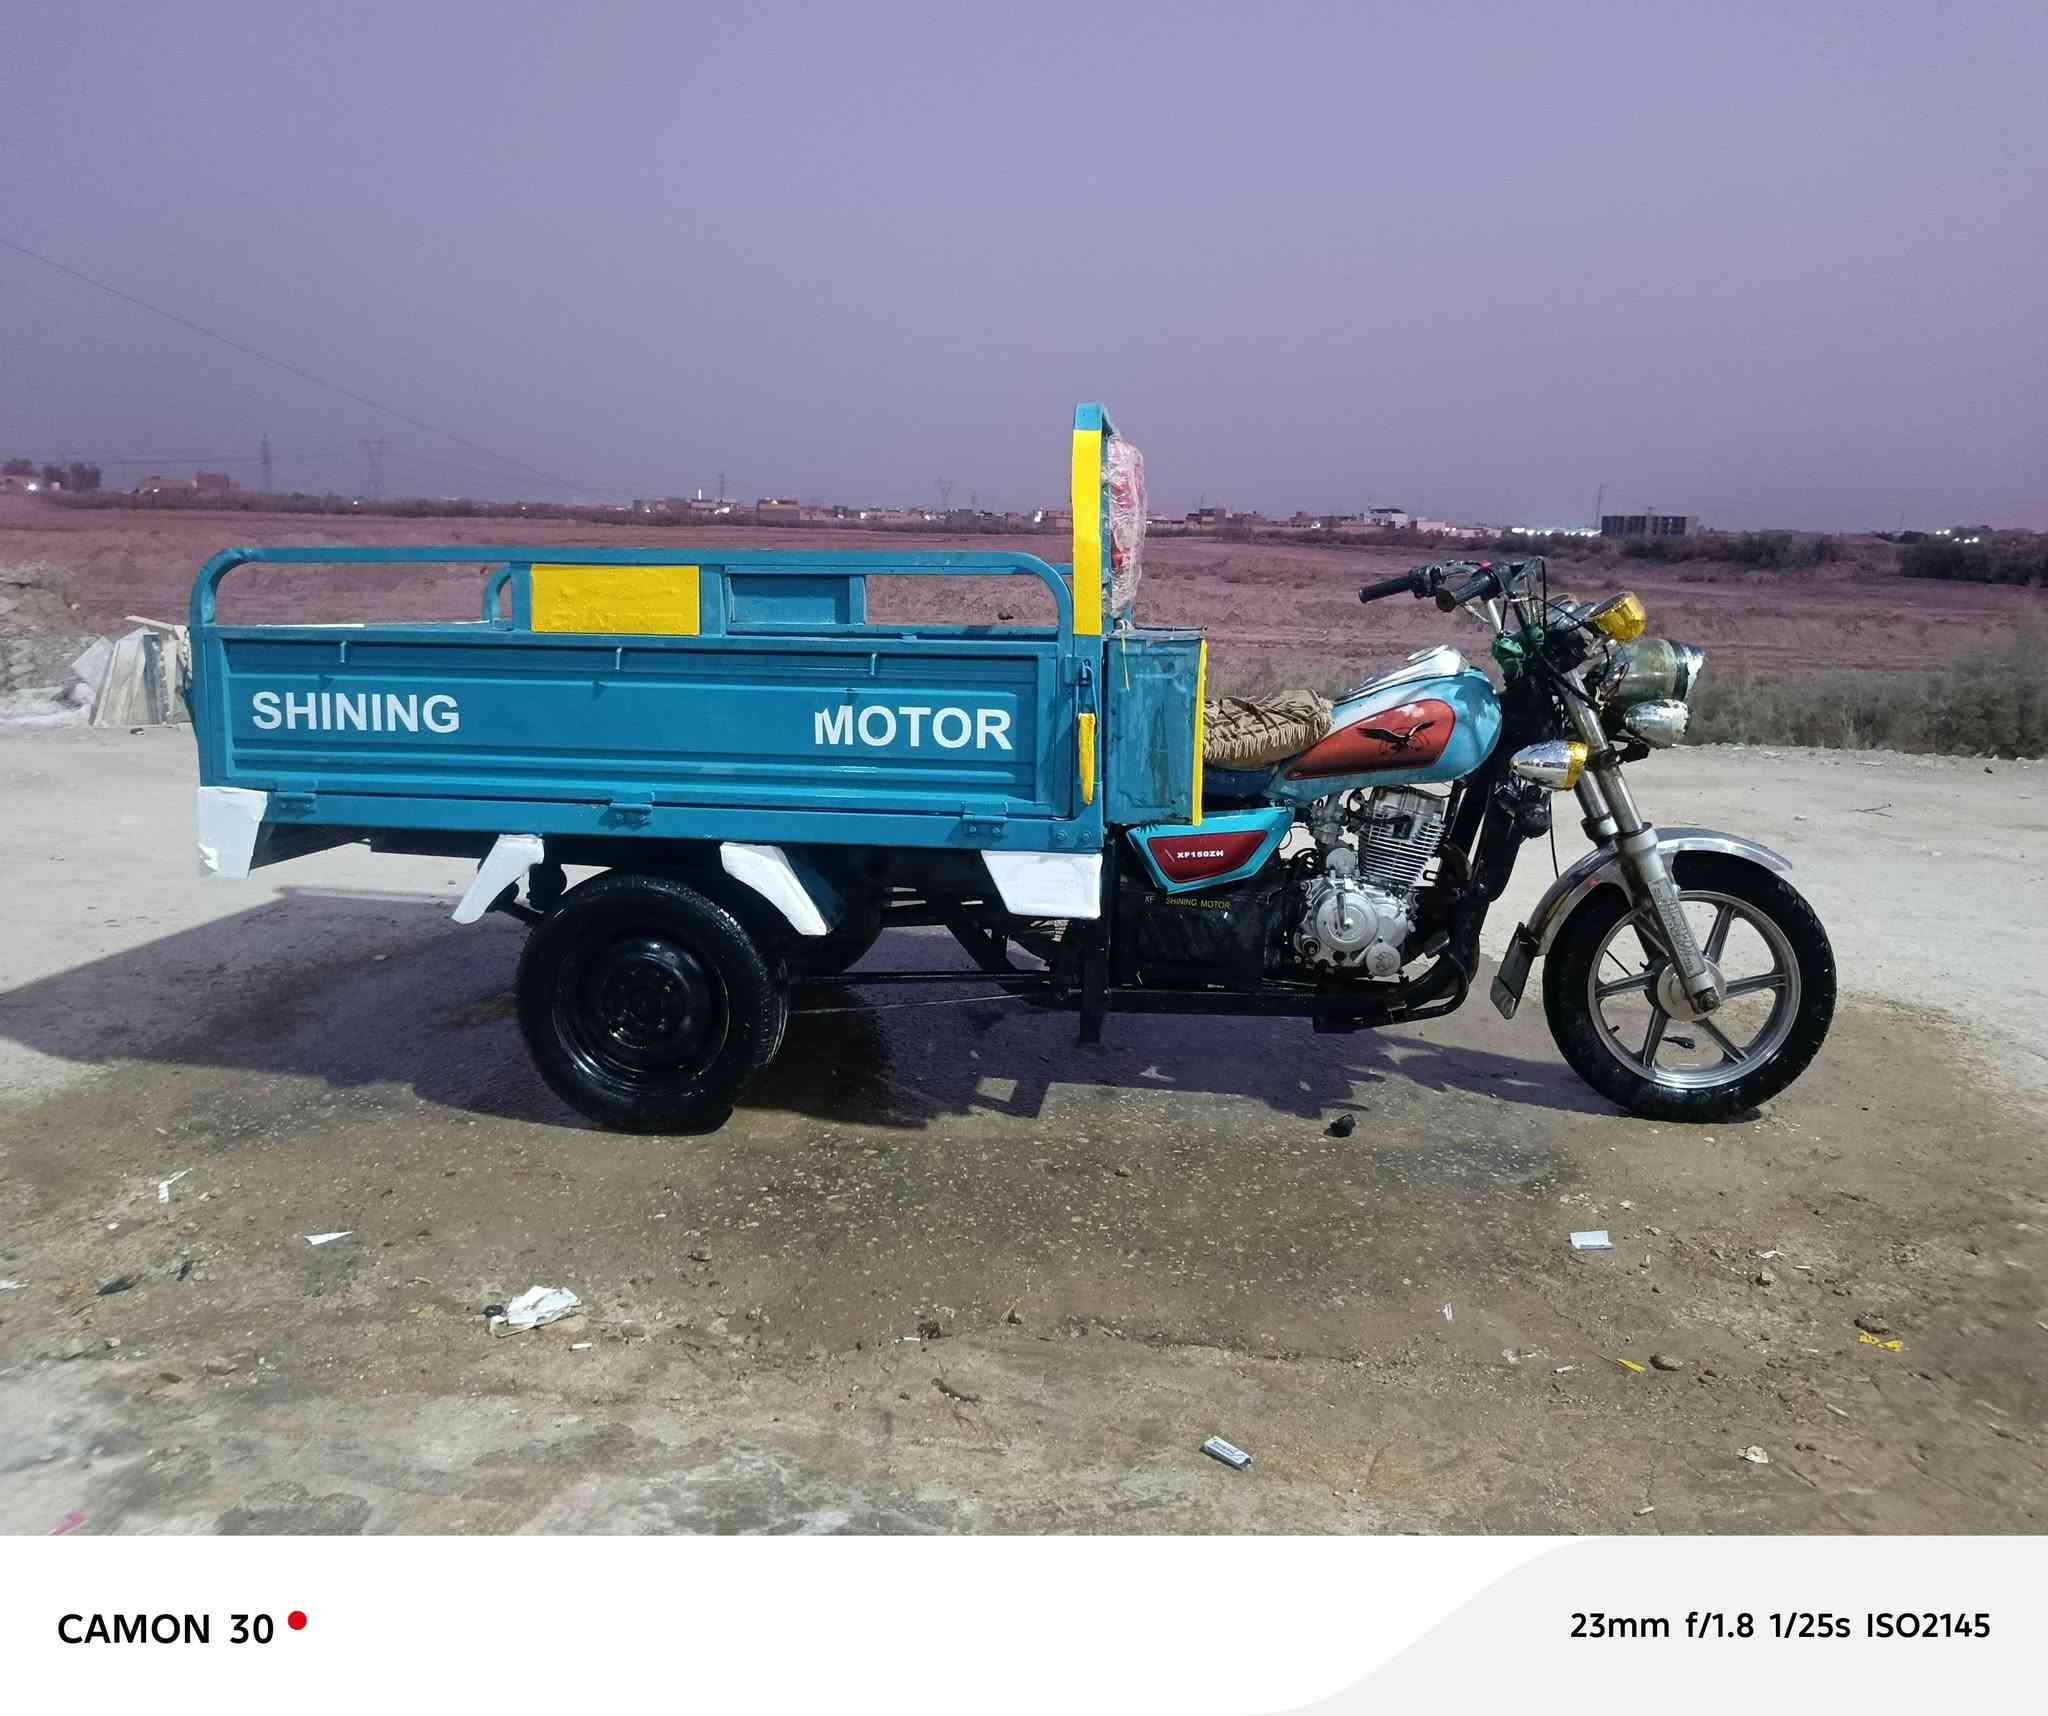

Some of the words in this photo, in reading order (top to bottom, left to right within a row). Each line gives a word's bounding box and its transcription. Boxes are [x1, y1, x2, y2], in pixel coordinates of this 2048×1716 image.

[252, 691, 460, 734] SHINING
[814, 705, 1012, 750] MOTOR
[1166, 897, 1198, 906] SHINING
[1200, 900, 1232, 909] MOTOR
